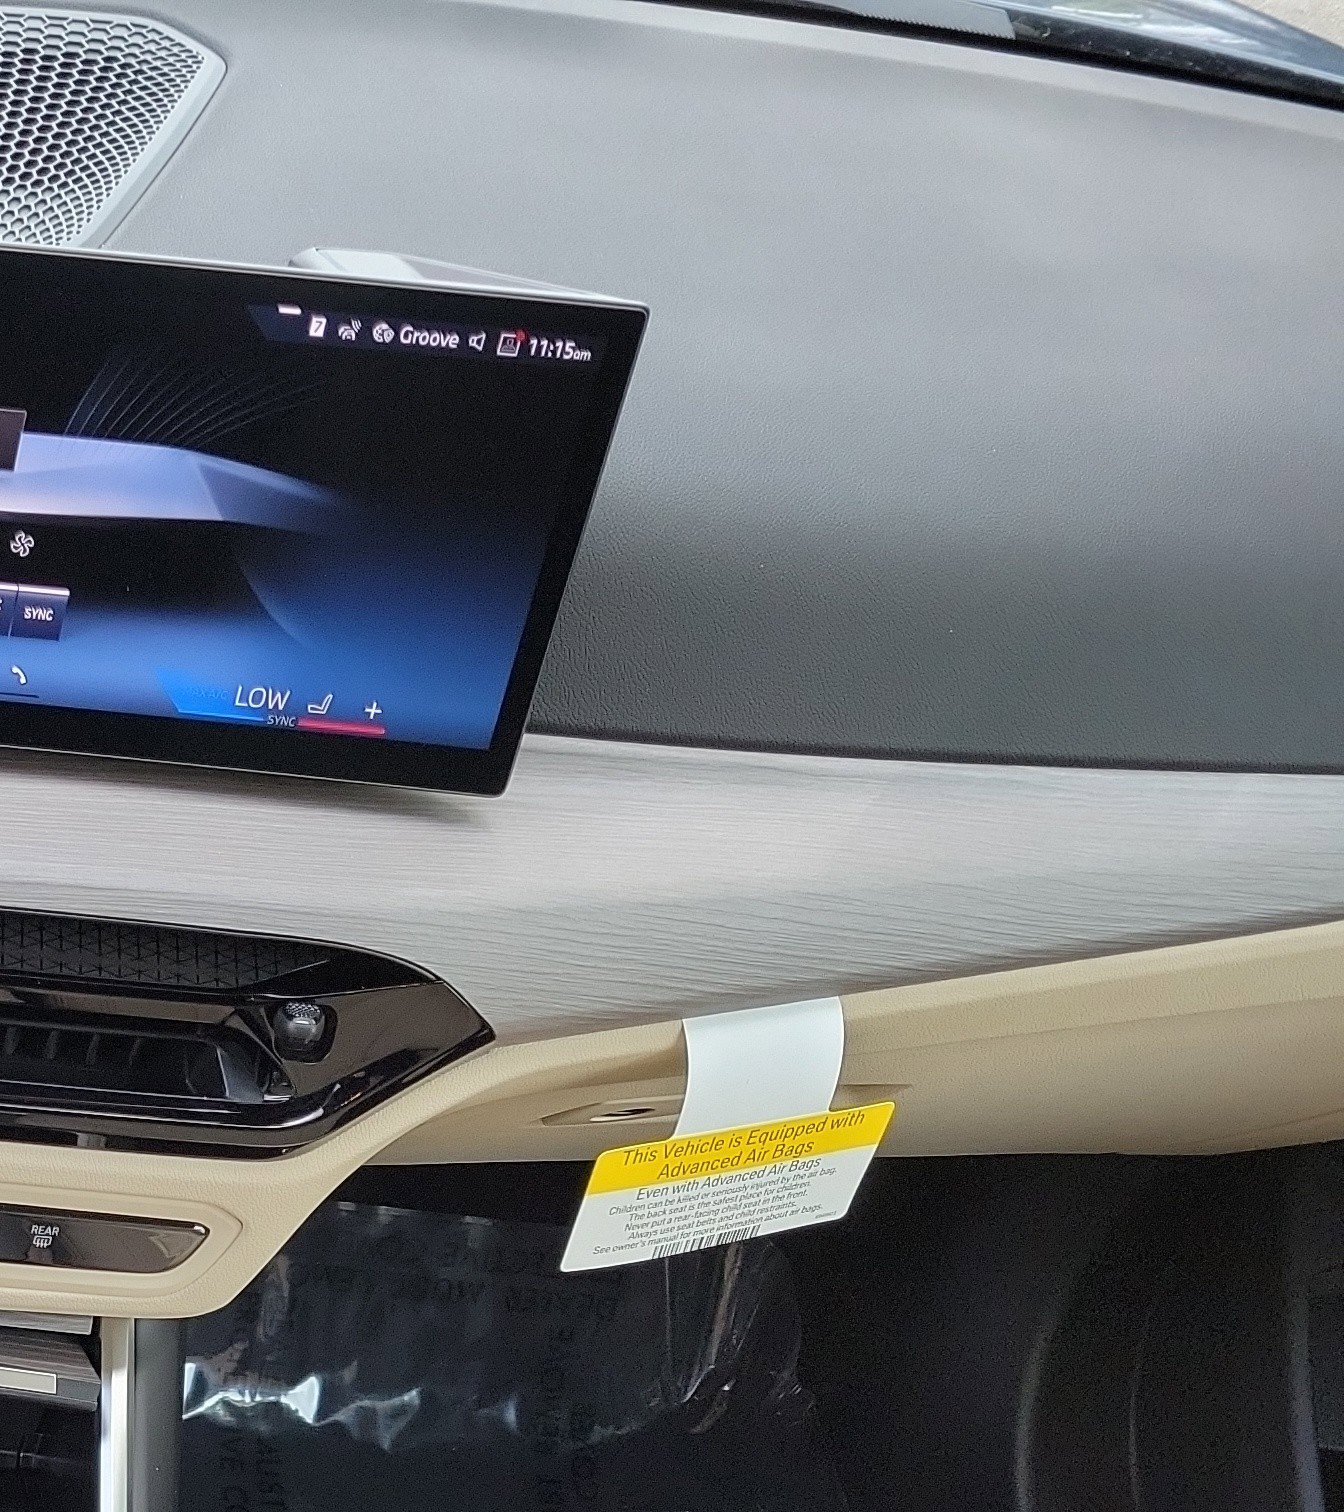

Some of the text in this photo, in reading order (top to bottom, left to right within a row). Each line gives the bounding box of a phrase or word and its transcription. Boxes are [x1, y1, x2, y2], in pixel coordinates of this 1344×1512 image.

[400, 325, 459, 349] Groove
[23, 607, 54, 621] SYNC
[235, 685, 291, 711] LOW
[267, 715, 296, 727] SYNC
[623, 1110, 864, 1165] This Vehicle is Equipped with
[657, 1141, 814, 1178] Advanced Air Bags
[608, 1203, 645, 1215] Children
[646, 1200, 663, 1209] can
[663, 1198, 675, 1206] be
[676, 1192, 700, 1204] killed
[711, 1183, 749, 1197] seriously
[750, 1177, 780, 1190] injured
[780, 1176, 791, 1184] by
[792, 1173, 806, 1181] the
[807, 1170, 818, 1178] air
[818, 1167, 836, 1176] bag.
[636, 1158, 821, 1200] Even with Advanced Air Bags
[624, 1221, 650, 1231] Never
[650, 1217, 666, 1228] put
[673, 1208, 720, 1222] rear-facing
[720, 1202, 742, 1213] child
[742, 1198, 761, 1209] seat
[761, 1197, 770, 1205] in
[771, 1194, 785, 1203] the
[786, 1189, 807, 1199] front.
[629, 1212, 645, 1221] The
[646, 1207, 666, 1218] back
[668, 1204, 687, 1214] seat
[696, 1200, 711, 1209] the
[712, 1194, 738, 1206] safest
[738, 1191, 762, 1202] place
[763, 1188, 775, 1196] for
[31, 1225, 59, 1237] REAR
[592, 1207, 800, 1254] See owner's manual for more information about air
[627, 1208, 756, 1240] Always use seat belts and child
